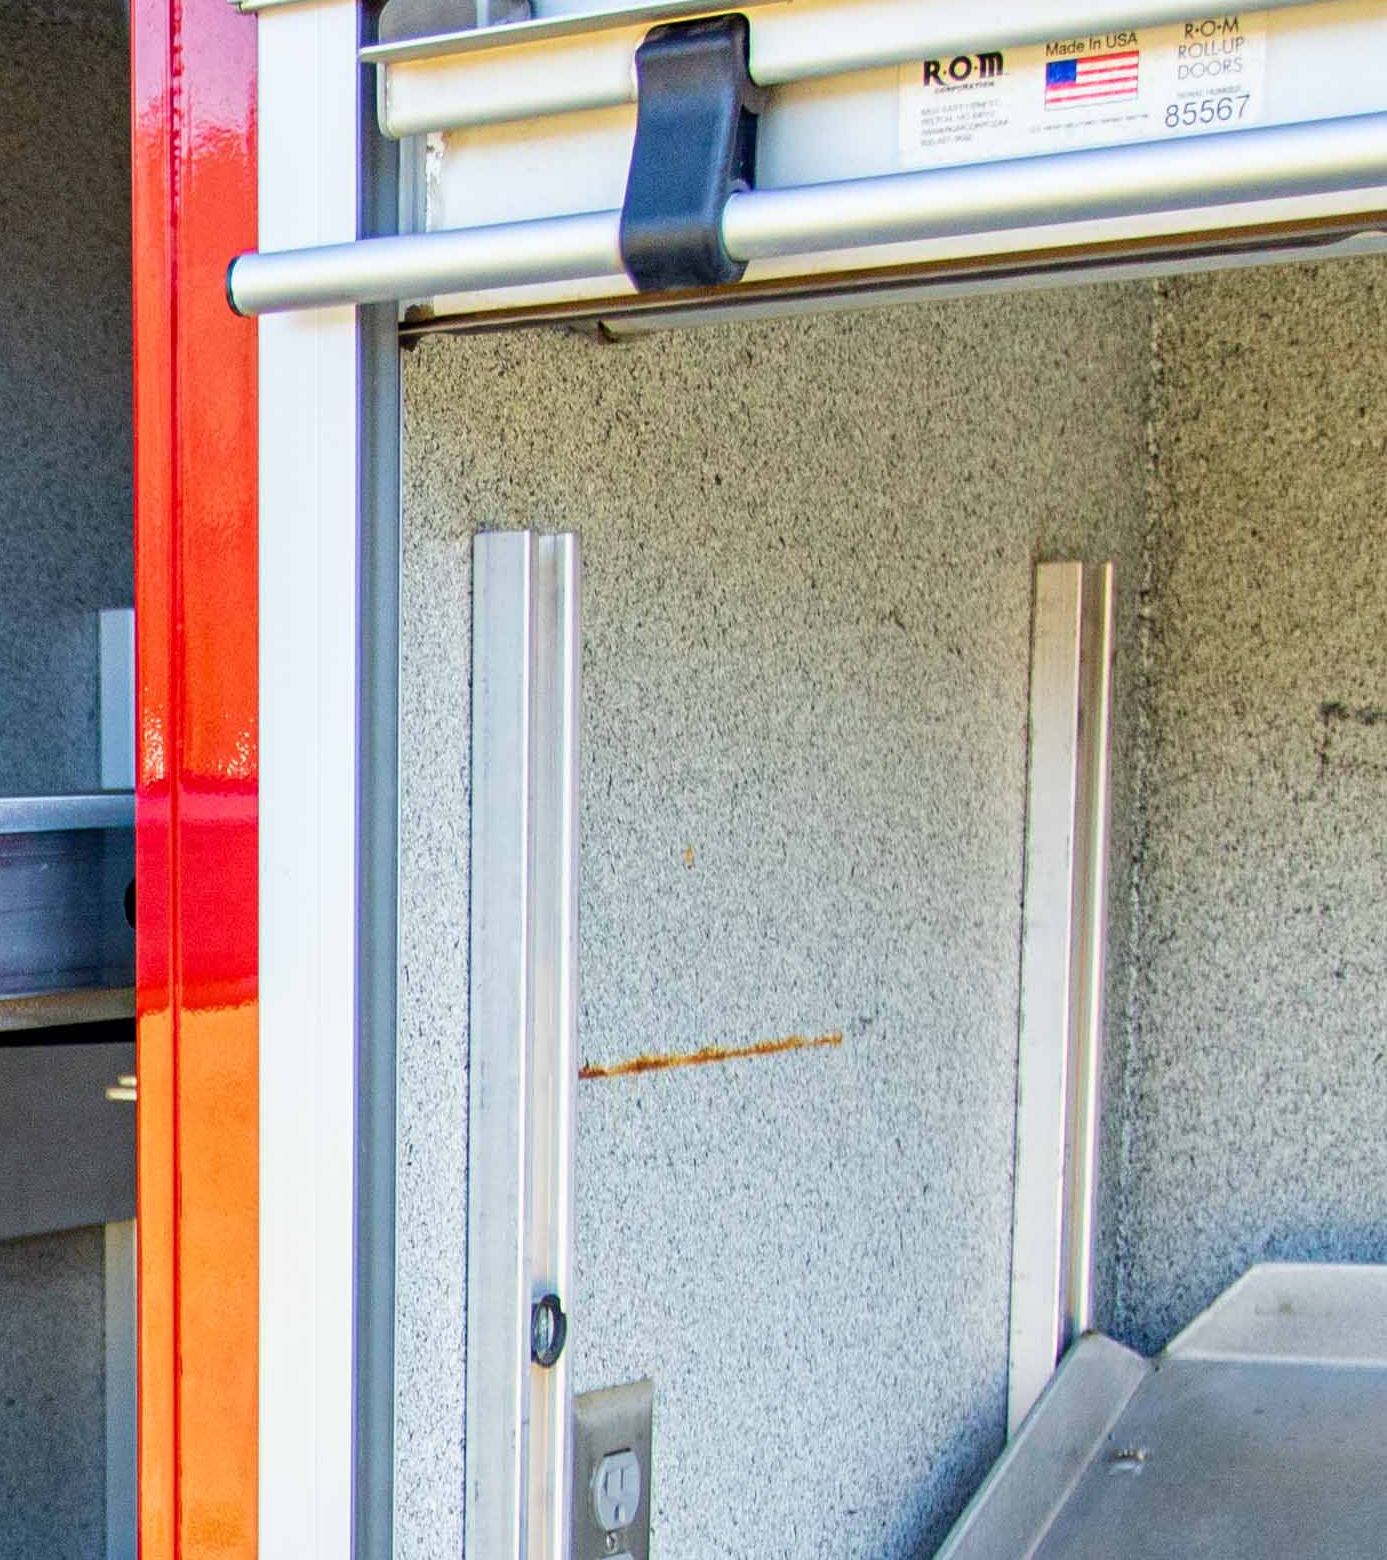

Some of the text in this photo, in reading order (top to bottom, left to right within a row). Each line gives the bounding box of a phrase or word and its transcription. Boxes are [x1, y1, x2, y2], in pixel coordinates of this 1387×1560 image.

[1045, 41, 1085, 57] Made
[1107, 32, 1138, 48] USA
[1178, 36, 1245, 59] ROLL-UP
[1178, 57, 1243, 80] DOORS
[1165, 94, 1251, 128] 85567
